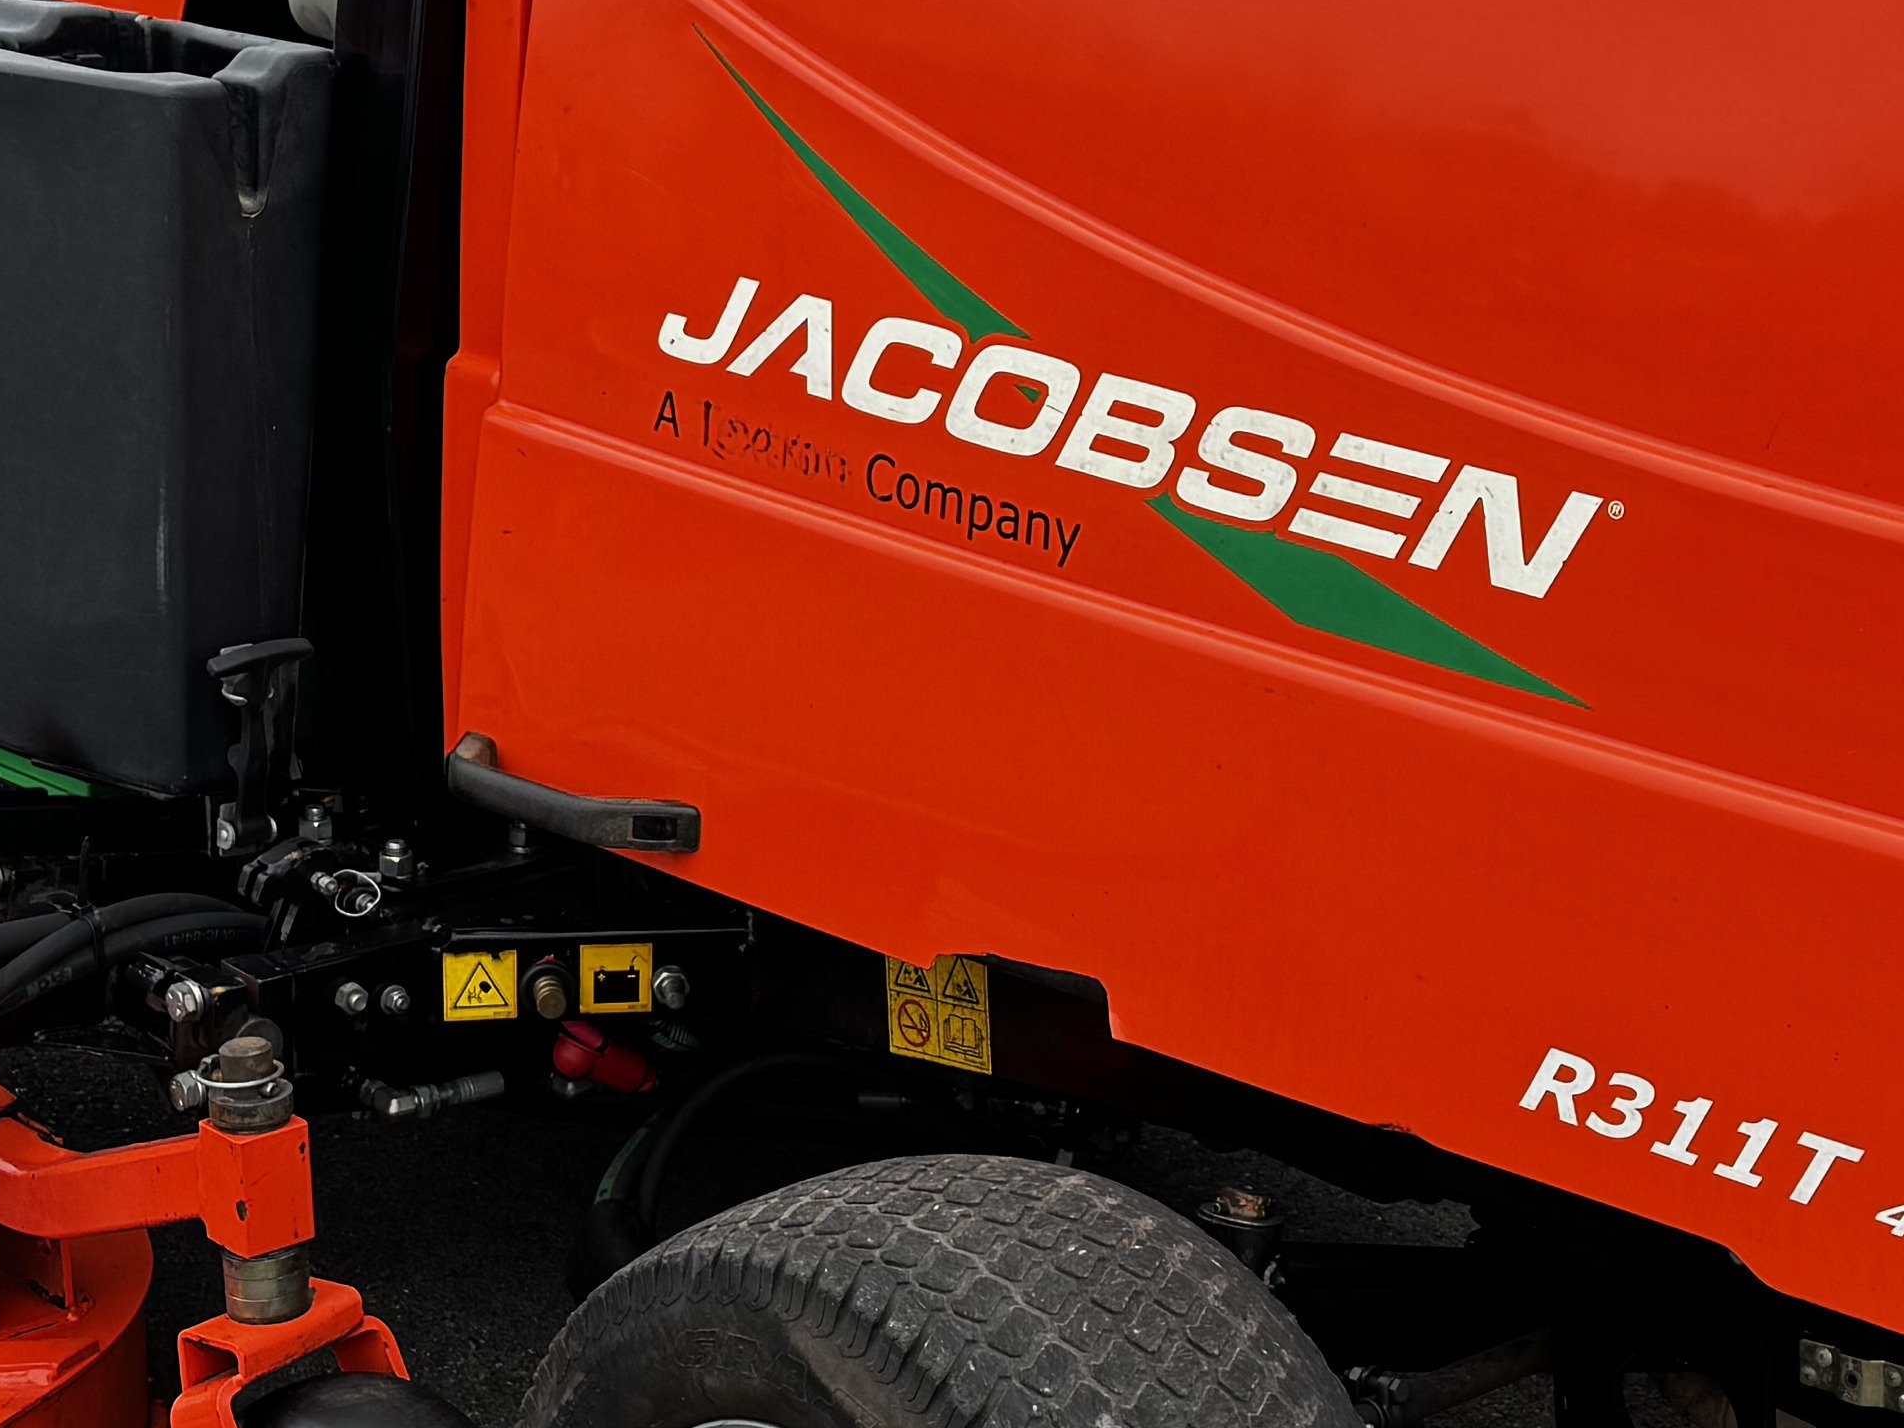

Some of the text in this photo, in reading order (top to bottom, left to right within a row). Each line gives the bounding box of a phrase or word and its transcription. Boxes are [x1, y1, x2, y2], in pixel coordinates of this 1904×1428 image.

[654, 389, 681, 438] A
[865, 452, 1082, 569] Company
[659, 277, 1603, 598] JACOBSEN
[1520, 1048, 1864, 1204] R311T
